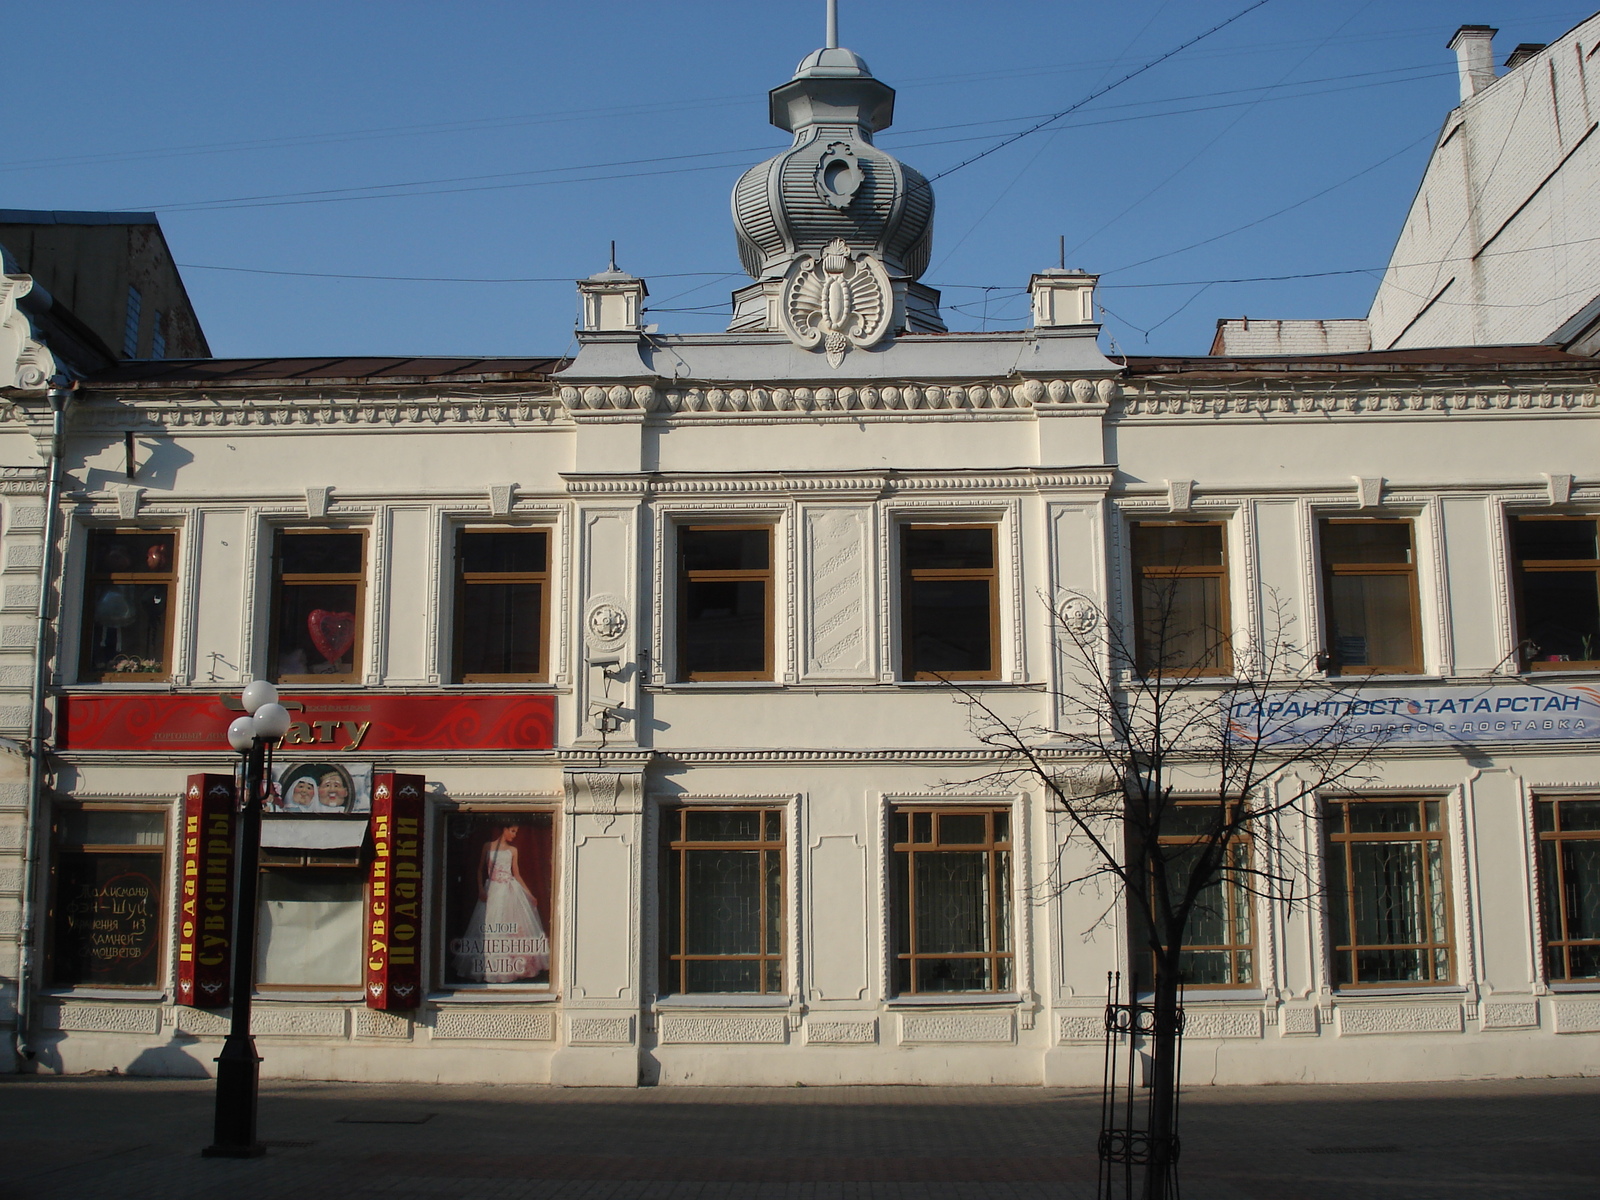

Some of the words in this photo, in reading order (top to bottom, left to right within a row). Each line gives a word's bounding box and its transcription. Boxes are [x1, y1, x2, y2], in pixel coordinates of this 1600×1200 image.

[1234, 699, 1404, 718] ГАРАНТПОСТ
[1424, 695, 1580, 714] ТАТАРСТАН
[152, 731, 202, 740] ТОРГОВЫЙ
[1322, 718, 1587, 735] ЭКСПРЕСС-ДОСТАВКА
[179, 815, 199, 962] Подарки
[199, 813, 232, 966] Сувениры
[368, 815, 389, 971] Сувениры
[389, 817, 422, 965] Подарки
[480, 922, 518, 934] САЛОН
[450, 935, 547, 956] СВАДЕБНЫЙ
[473, 959, 524, 974] ВАЛЬС
